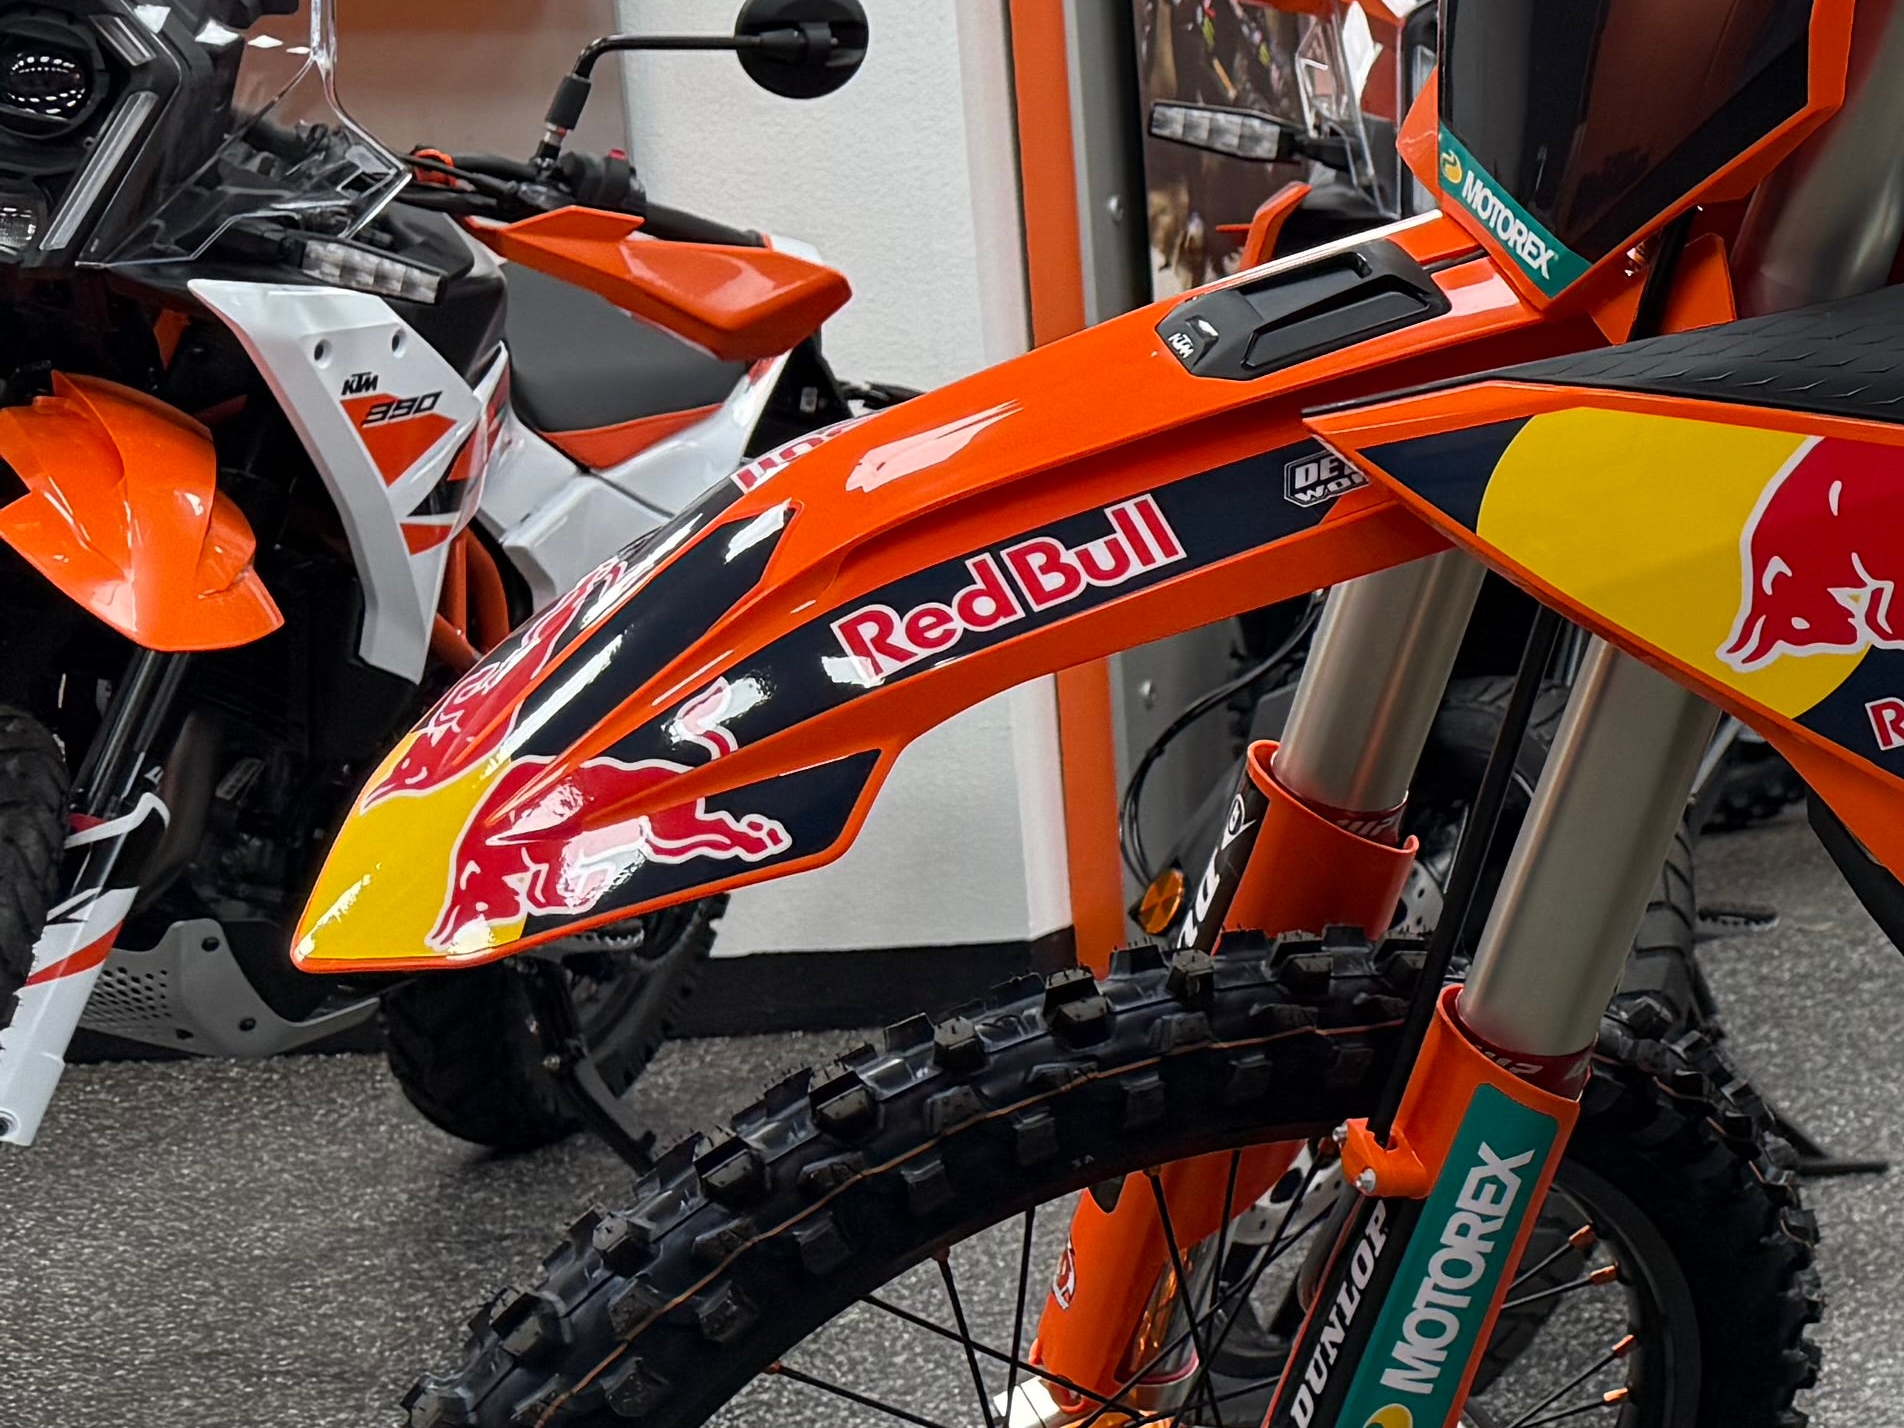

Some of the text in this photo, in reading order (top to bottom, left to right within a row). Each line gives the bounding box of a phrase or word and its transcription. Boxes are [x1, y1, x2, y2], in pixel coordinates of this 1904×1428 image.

[1460, 170, 1558, 280] MOTOREX
[340, 371, 379, 396] KTM
[1167, 332, 1195, 359] KTM
[831, 493, 1187, 678] Red Bull
[1380, 1141, 1537, 1396] MOTOREX
